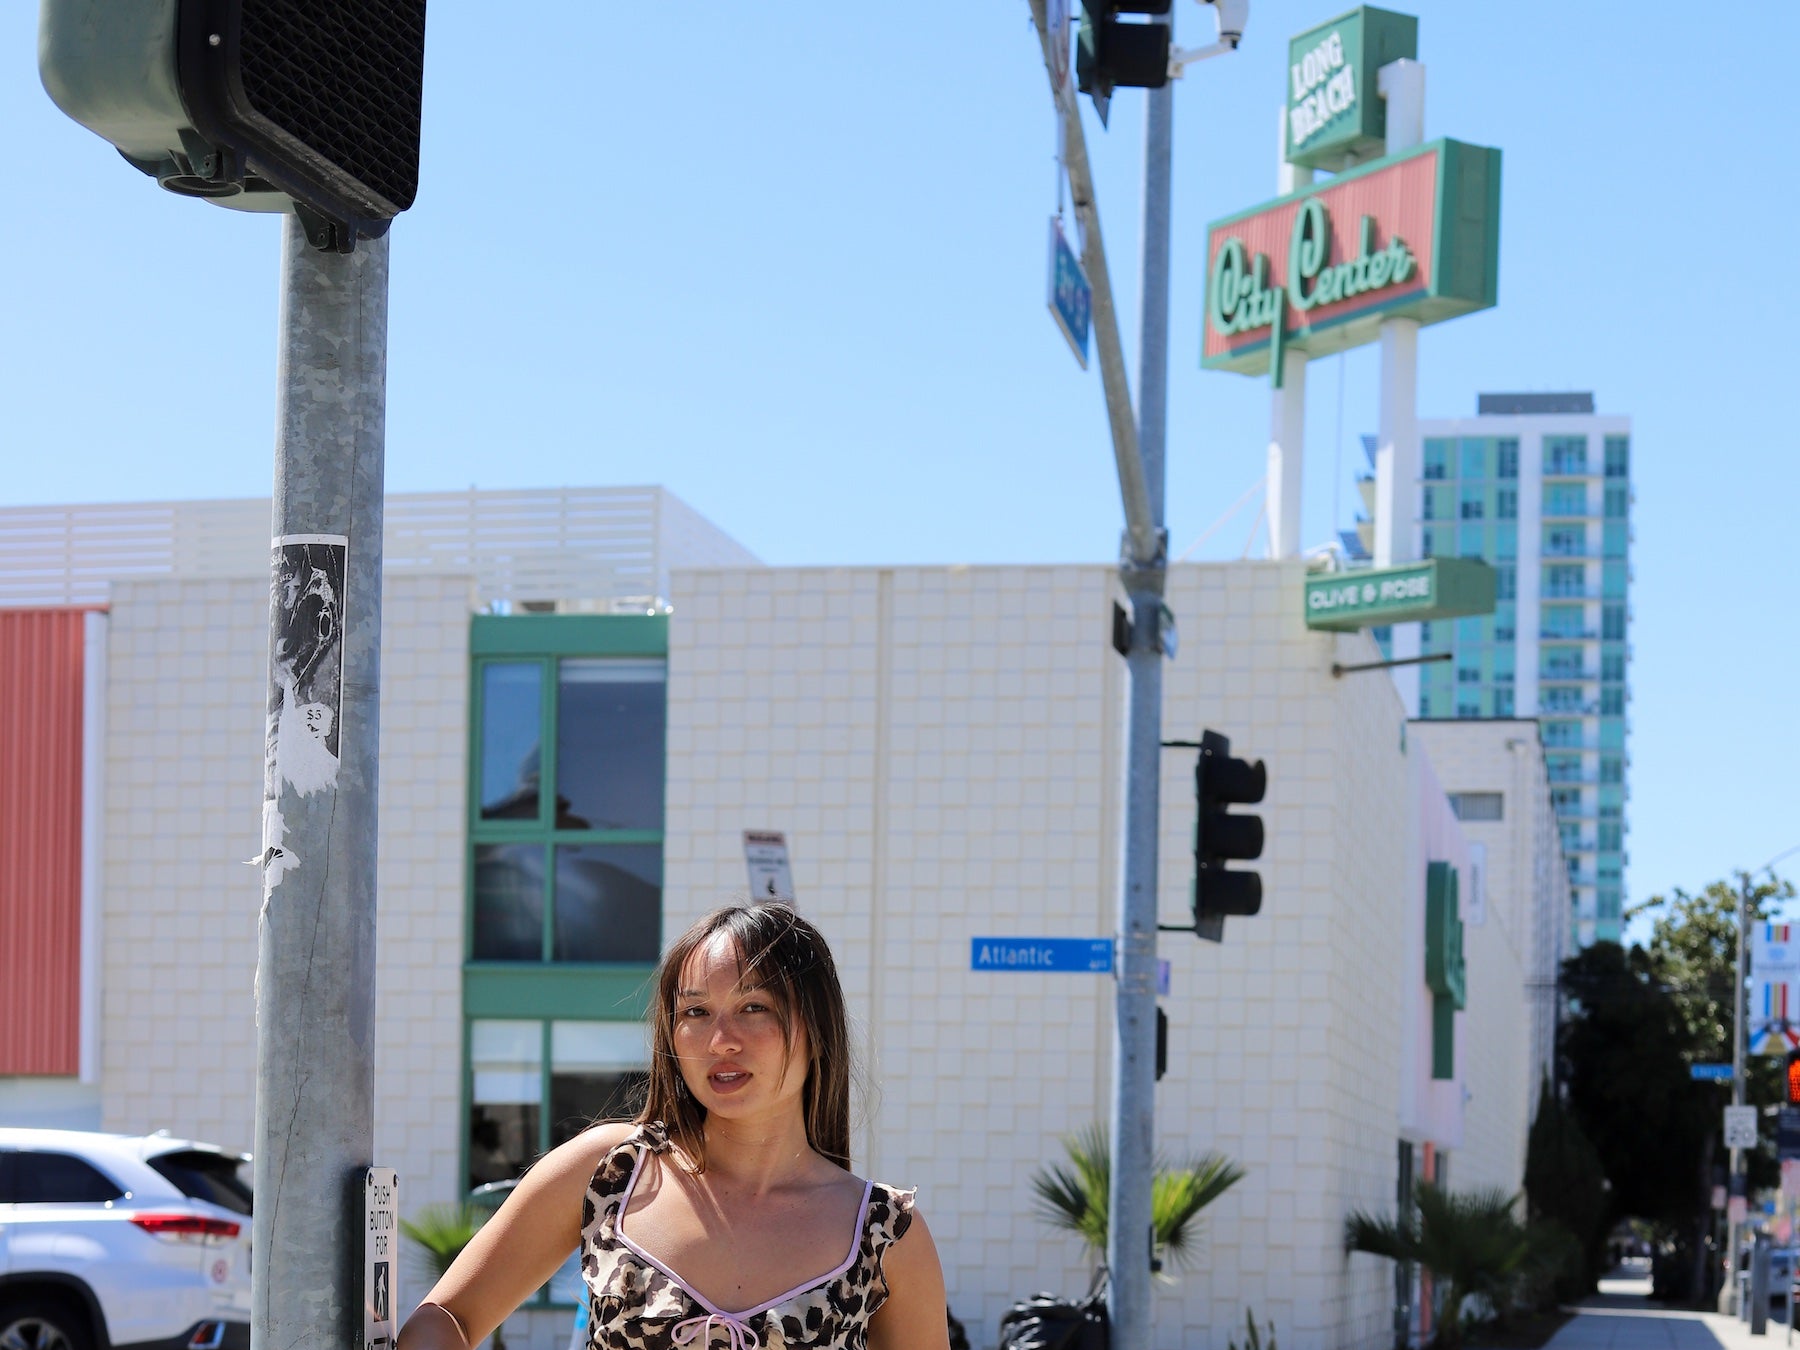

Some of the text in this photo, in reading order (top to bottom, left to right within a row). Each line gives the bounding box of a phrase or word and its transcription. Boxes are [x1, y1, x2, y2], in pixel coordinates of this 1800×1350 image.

[1291, 30, 1345, 102] LONG
[1289, 62, 1356, 145] BEACH
[1210, 236, 1286, 389] City
[1287, 196, 1418, 311] Center
[1308, 585, 1359, 610] OLIVE
[1381, 576, 1430, 600] ROSE
[307, 709, 322, 720] $5
[978, 944, 1054, 966] Atlantic
[373, 1185, 391, 1206] PUSH
[369, 1210, 394, 1231] BUTTON
[375, 1235, 389, 1256] FOR
